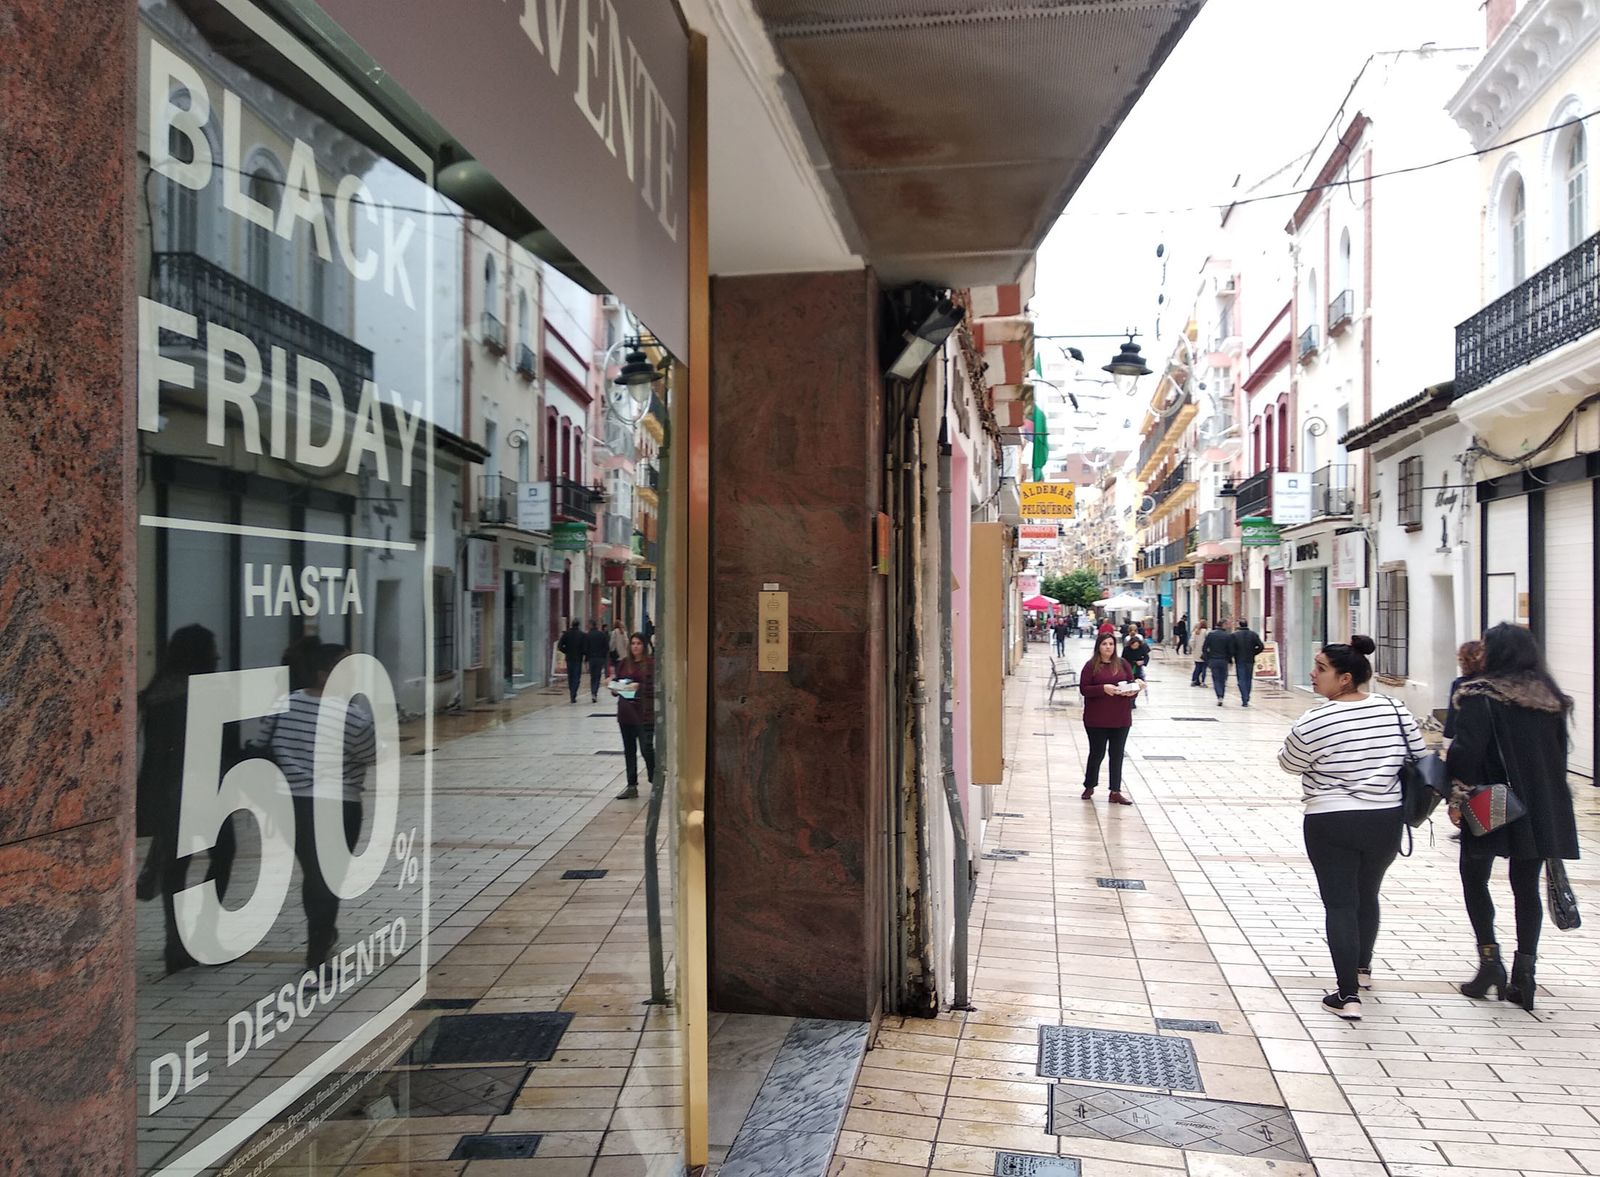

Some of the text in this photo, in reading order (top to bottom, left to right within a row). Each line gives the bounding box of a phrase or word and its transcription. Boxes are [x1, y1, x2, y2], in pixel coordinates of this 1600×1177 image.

[149, 39, 416, 310] BLACK
[519, 0, 677, 242] VENTE
[138, 296, 422, 486] FRIDAY
[1022, 485, 1073, 499] ALDEMAR
[1022, 504, 1072, 515] PELUQUEROS
[243, 563, 363, 617] HASTA
[173, 653, 402, 966] 50
[147, 916, 407, 1117] DE DESCUENTO
[287, 1100, 316, 1129] Precios
